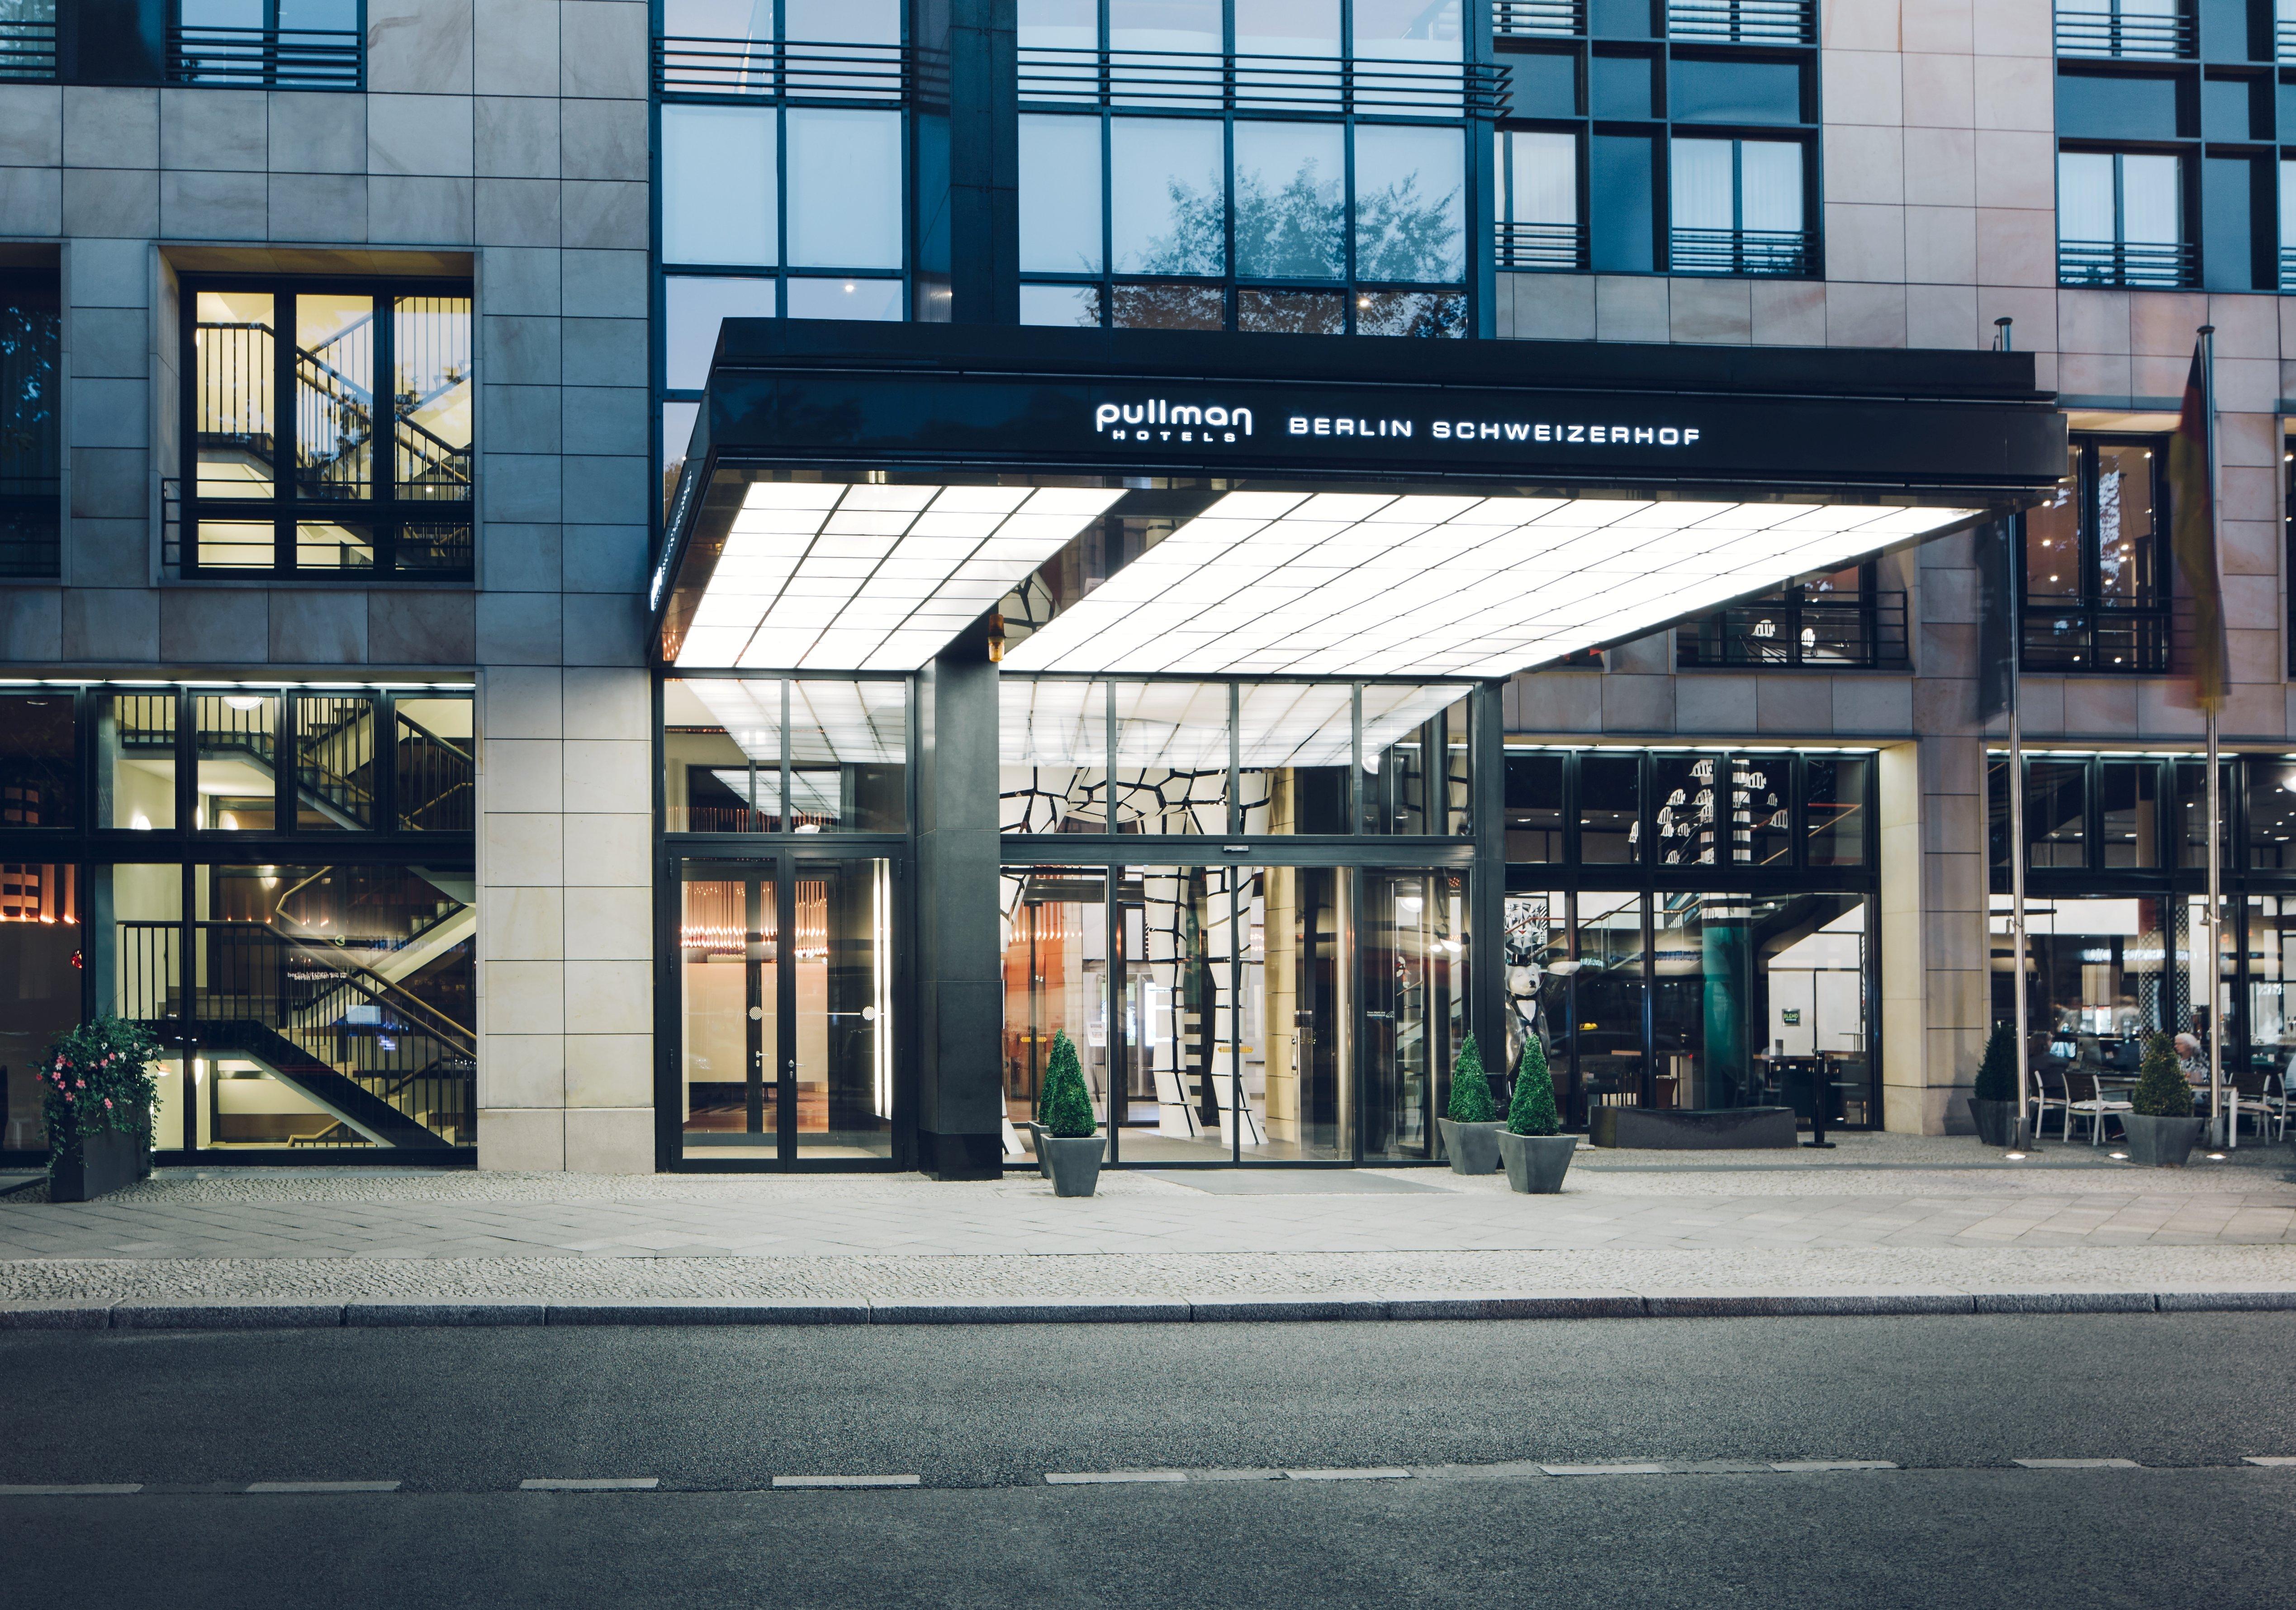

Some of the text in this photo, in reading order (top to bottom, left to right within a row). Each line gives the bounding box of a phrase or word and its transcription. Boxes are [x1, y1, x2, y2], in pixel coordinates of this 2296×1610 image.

[1096, 399, 1252, 436] pullman
[1289, 417, 1699, 445] BERLIN SCHWEIZERHOF
[1113, 430, 1236, 442] HOTELS
